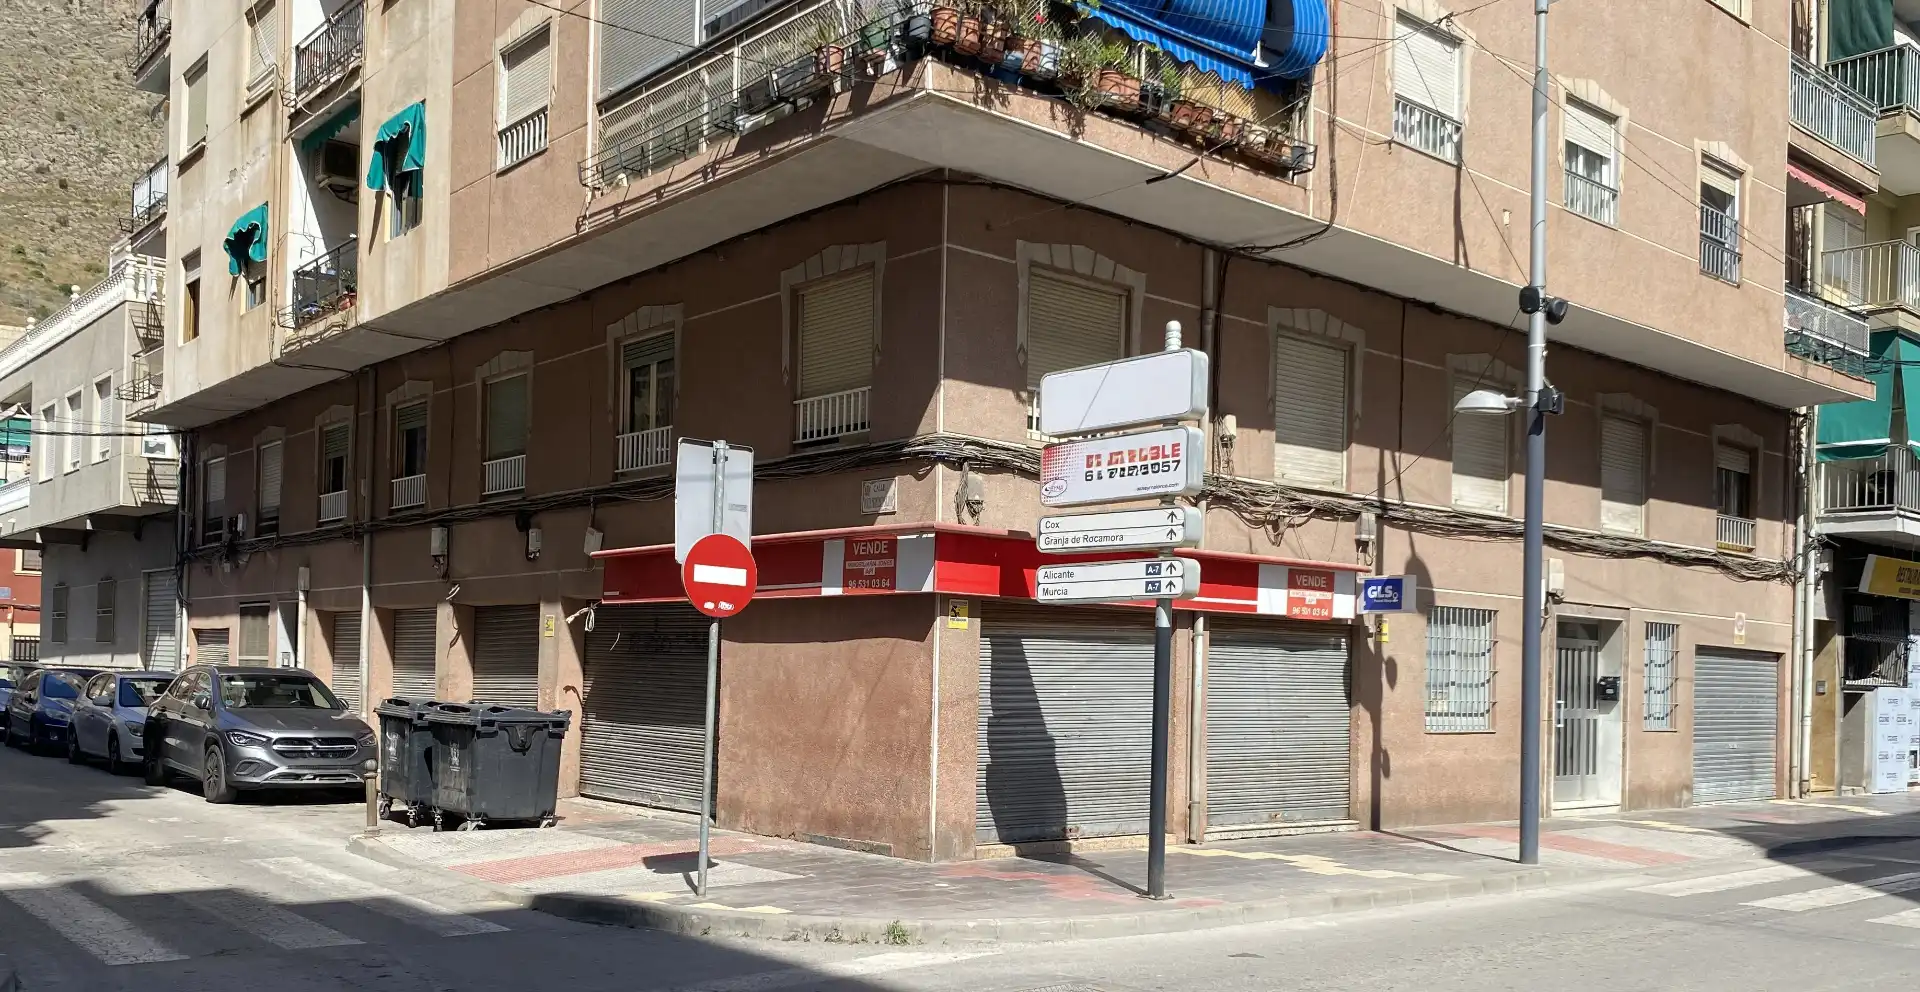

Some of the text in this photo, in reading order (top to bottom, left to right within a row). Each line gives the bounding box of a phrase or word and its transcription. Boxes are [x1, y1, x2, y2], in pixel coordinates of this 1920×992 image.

[1045, 520, 1060, 529] Cox
[1044, 534, 1124, 546] Granja de Rocamora
[852, 540, 889, 556] VENDE
[1043, 565, 1160, 579] Alicante A-7
[848, 578, 890, 589] 96 531 03 64
[1296, 574, 1327, 588] VENDE
[1042, 582, 1159, 596] Murcia A-7
[1292, 606, 1301, 615] 96
[1312, 607, 1320, 616] 03
